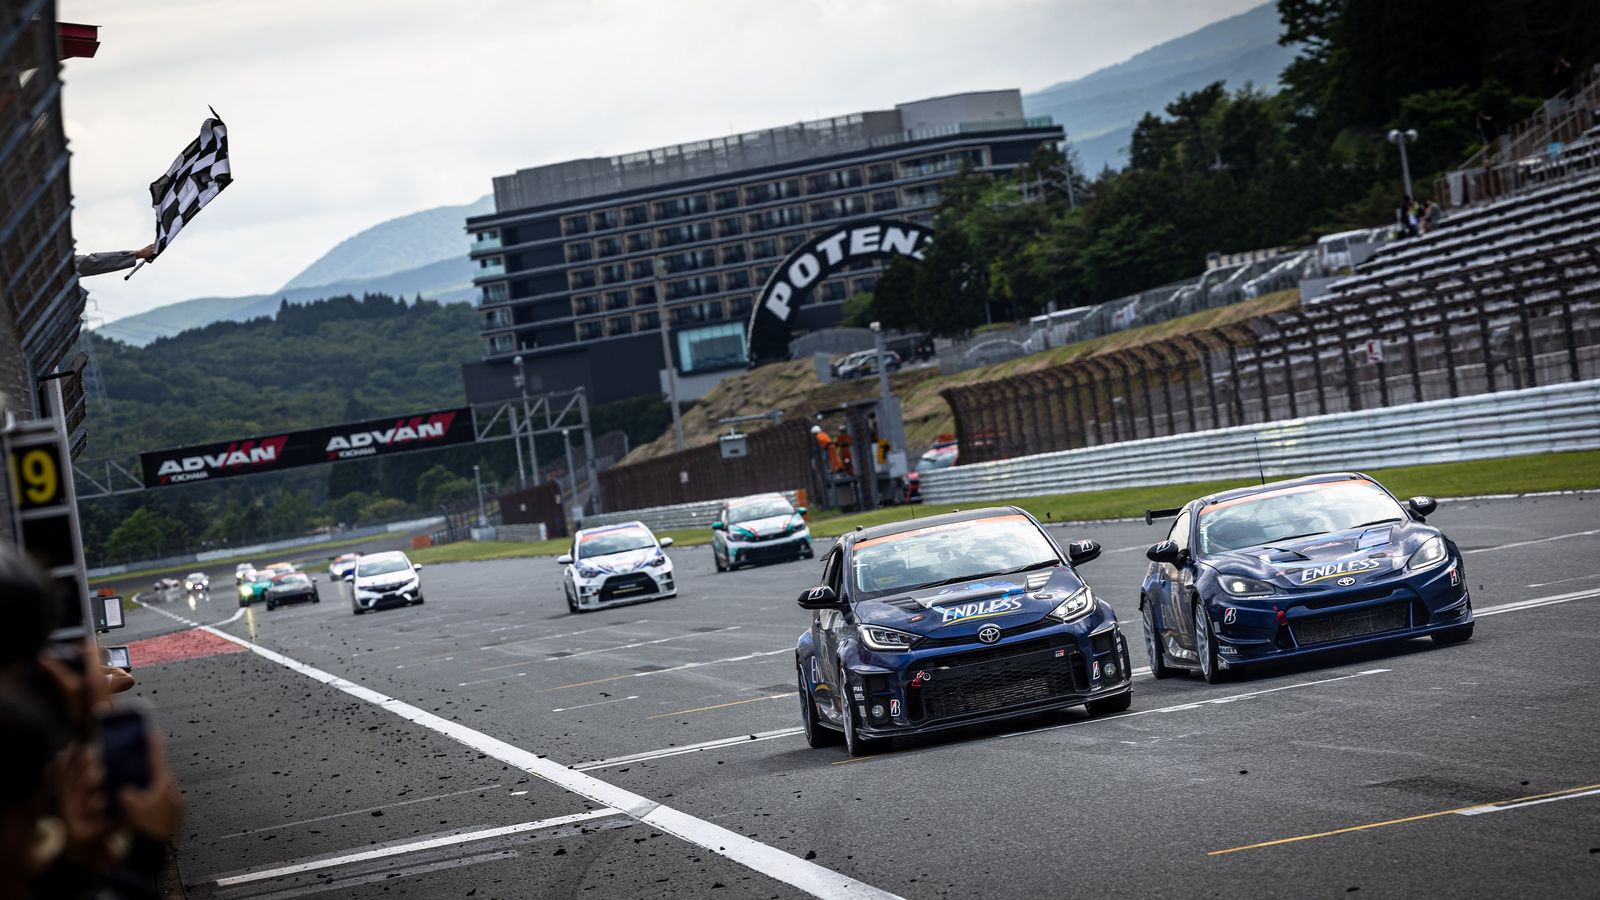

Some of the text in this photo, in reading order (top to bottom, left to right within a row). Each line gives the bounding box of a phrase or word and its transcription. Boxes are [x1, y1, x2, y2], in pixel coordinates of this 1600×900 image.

[325, 421, 444, 452] ADVAN
[158, 445, 277, 476] ADVAN
[338, 446, 376, 459] YOKOHAMA
[170, 471, 209, 483] YOKOHAMA
[1301, 558, 1380, 582] ENDLESS
[942, 596, 1024, 623] ENDLESS
